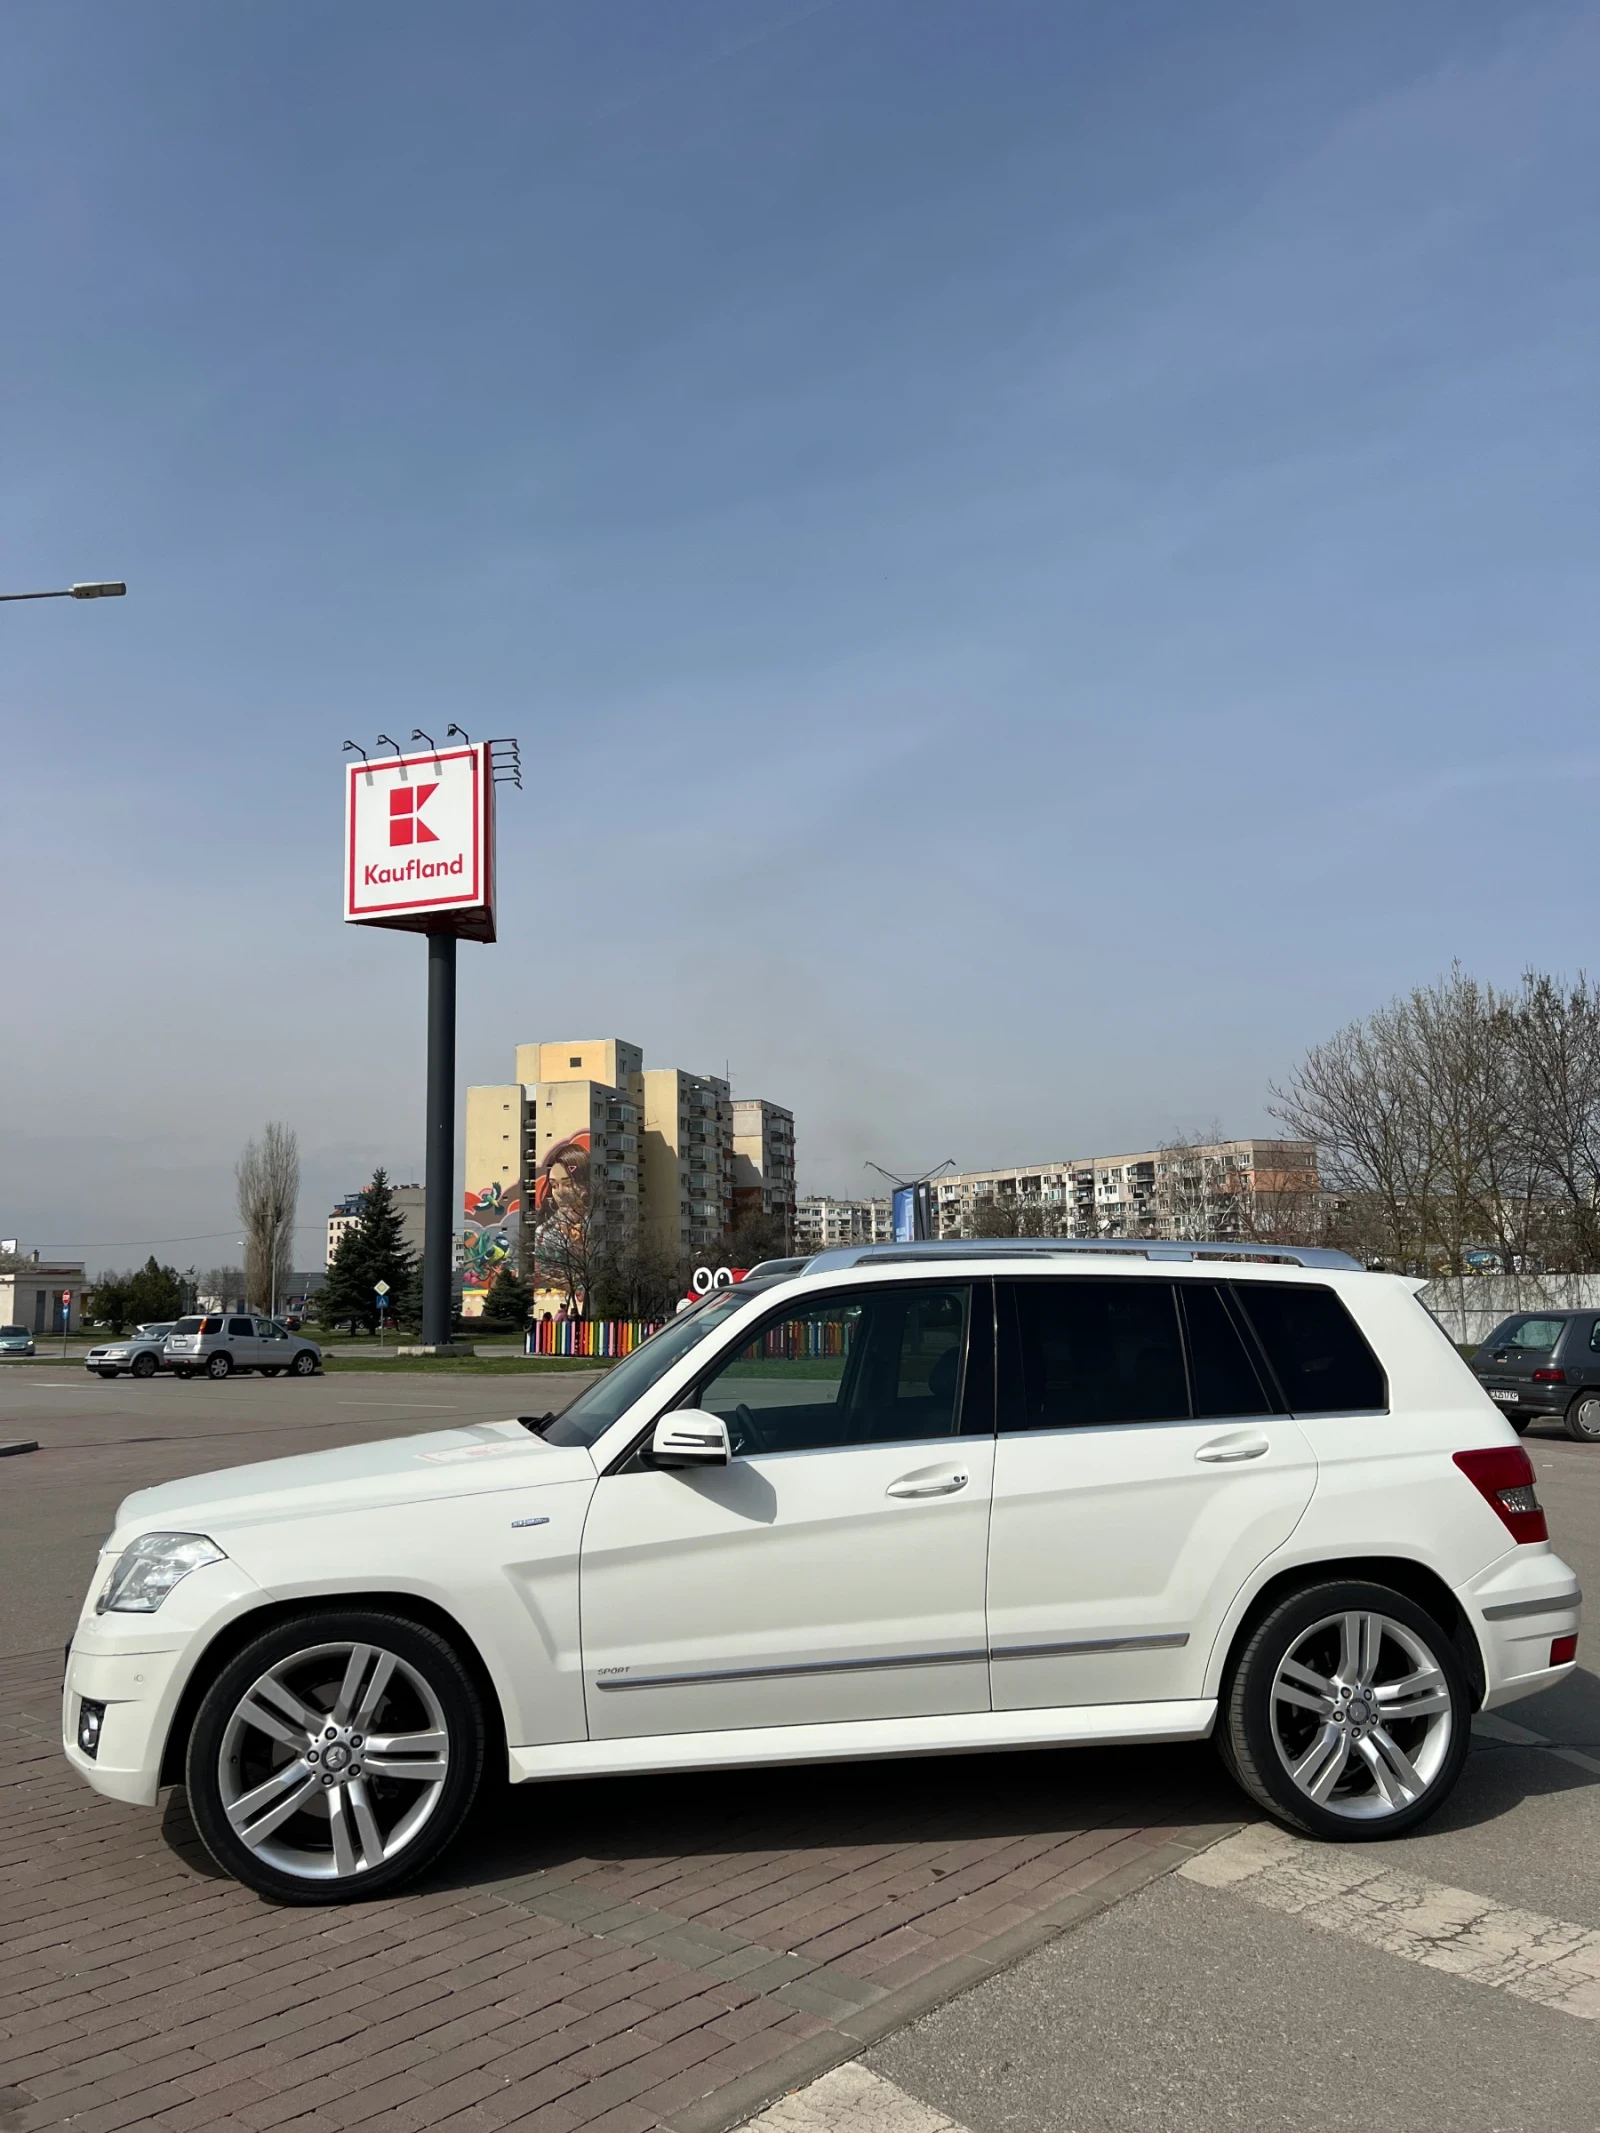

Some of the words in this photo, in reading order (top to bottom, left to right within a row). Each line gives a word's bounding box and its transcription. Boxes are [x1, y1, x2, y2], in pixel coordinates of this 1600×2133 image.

[389, 782, 440, 847] K
[364, 853, 463, 886] Kaufland
[597, 1666, 630, 1675] SPORT
